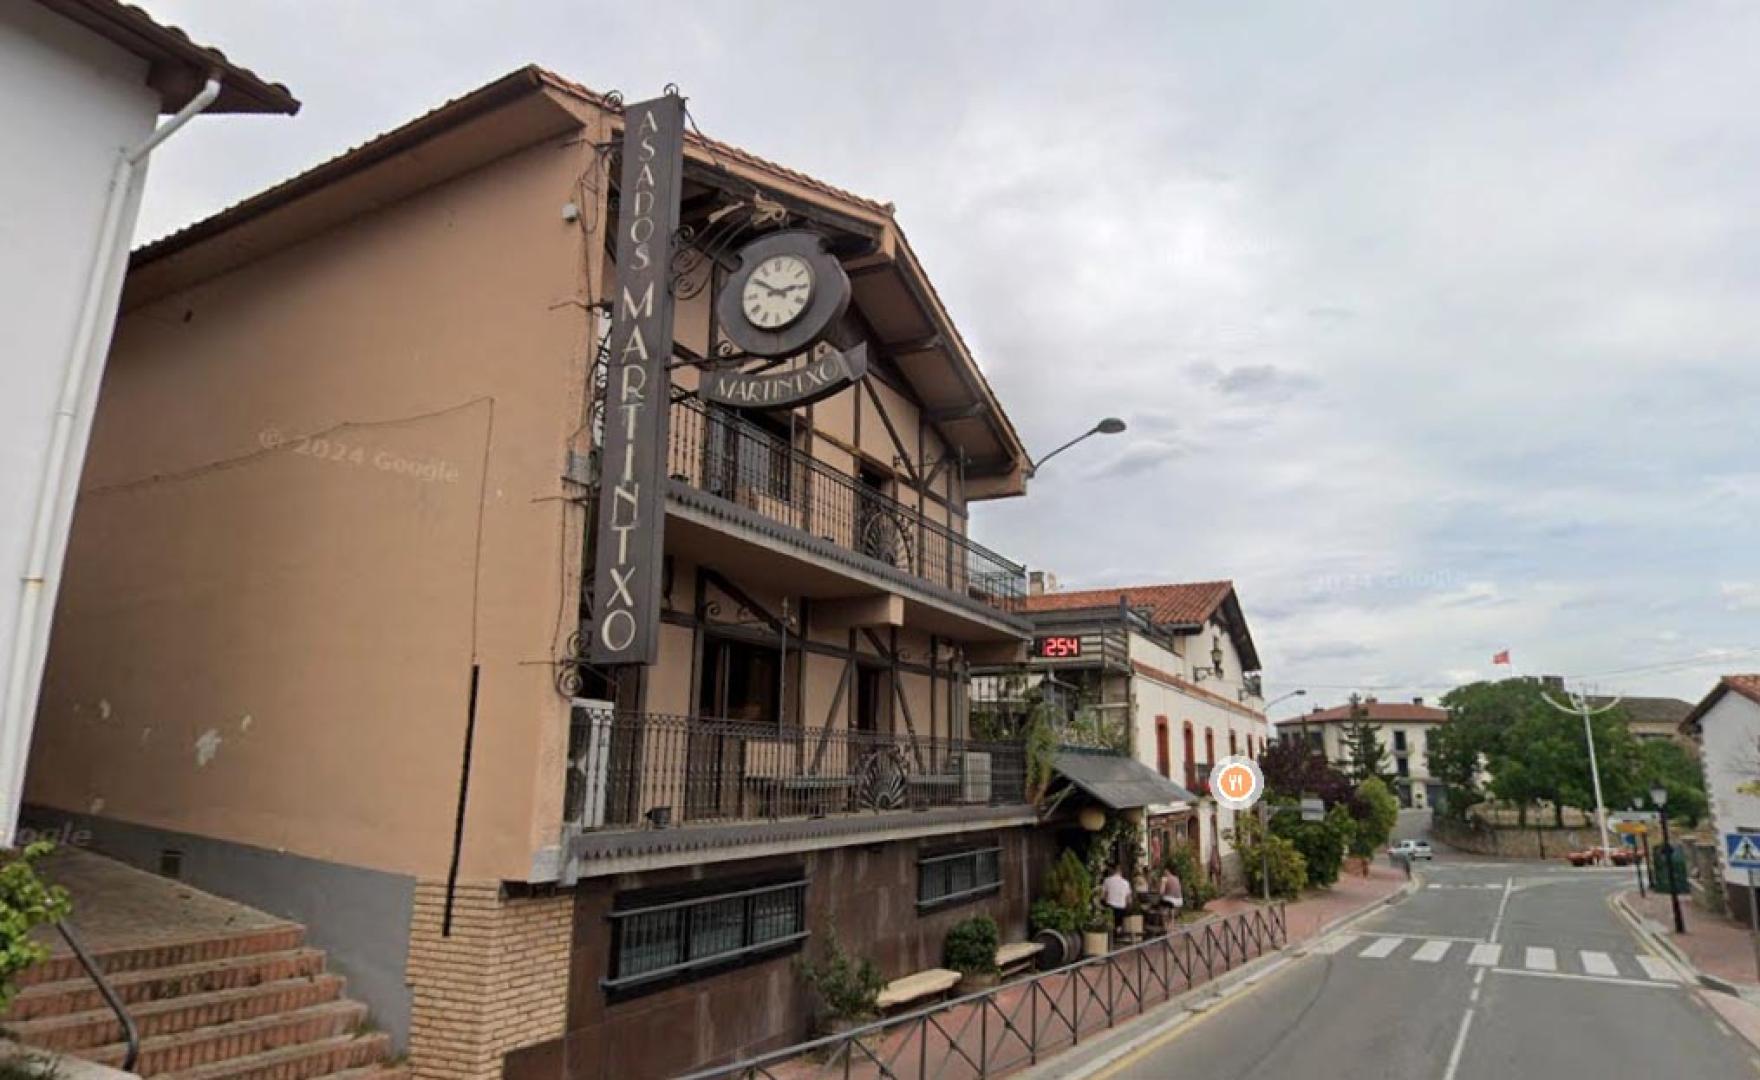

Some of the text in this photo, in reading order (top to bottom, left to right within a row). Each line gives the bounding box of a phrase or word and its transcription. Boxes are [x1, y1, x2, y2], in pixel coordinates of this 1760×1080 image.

[602, 110, 658, 652] ASADOS MARTINTXO
[715, 354, 839, 401] MARTINTXO
